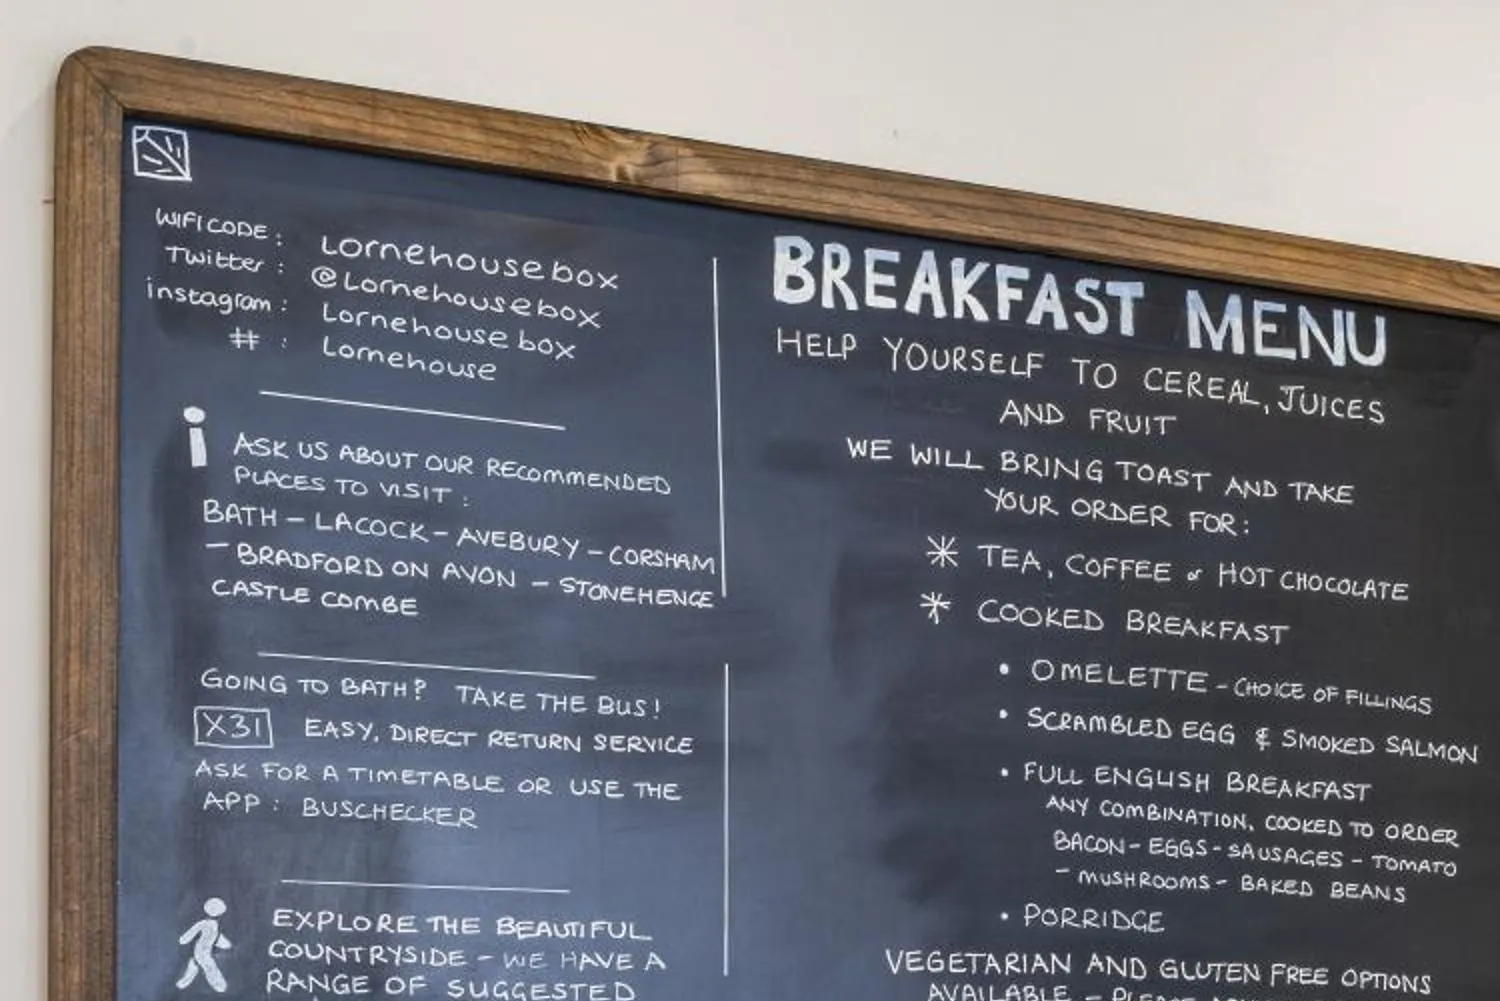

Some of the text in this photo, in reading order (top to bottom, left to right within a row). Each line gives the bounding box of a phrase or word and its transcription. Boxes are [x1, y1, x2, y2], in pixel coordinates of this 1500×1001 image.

[773, 235, 1386, 367] BREAKFAST MENU
[777, 328, 1385, 425] HELP YOURSELF TO CEREAL, JUICES
[233, 432, 671, 494] ASK US ABOUT OUR RECOMMENDED
[212, 579, 418, 616] CASTLE COMBE
[978, 599, 1290, 645] COOKED BREAKFAST
[201, 668, 659, 719] GOING TO BATH? TAKE THE BUS!
[203, 712, 693, 754] X31 EASY, DIRECT RETURN SERVICE
[1024, 761, 1372, 801] FULL ENGLISH BREAKFAST
[272, 909, 652, 940] EXPLORE THE BEAUTIFUL
[1024, 903, 1165, 933] PORRIDGE
[266, 968, 635, 1001] RANGE OF SUGGESTED
